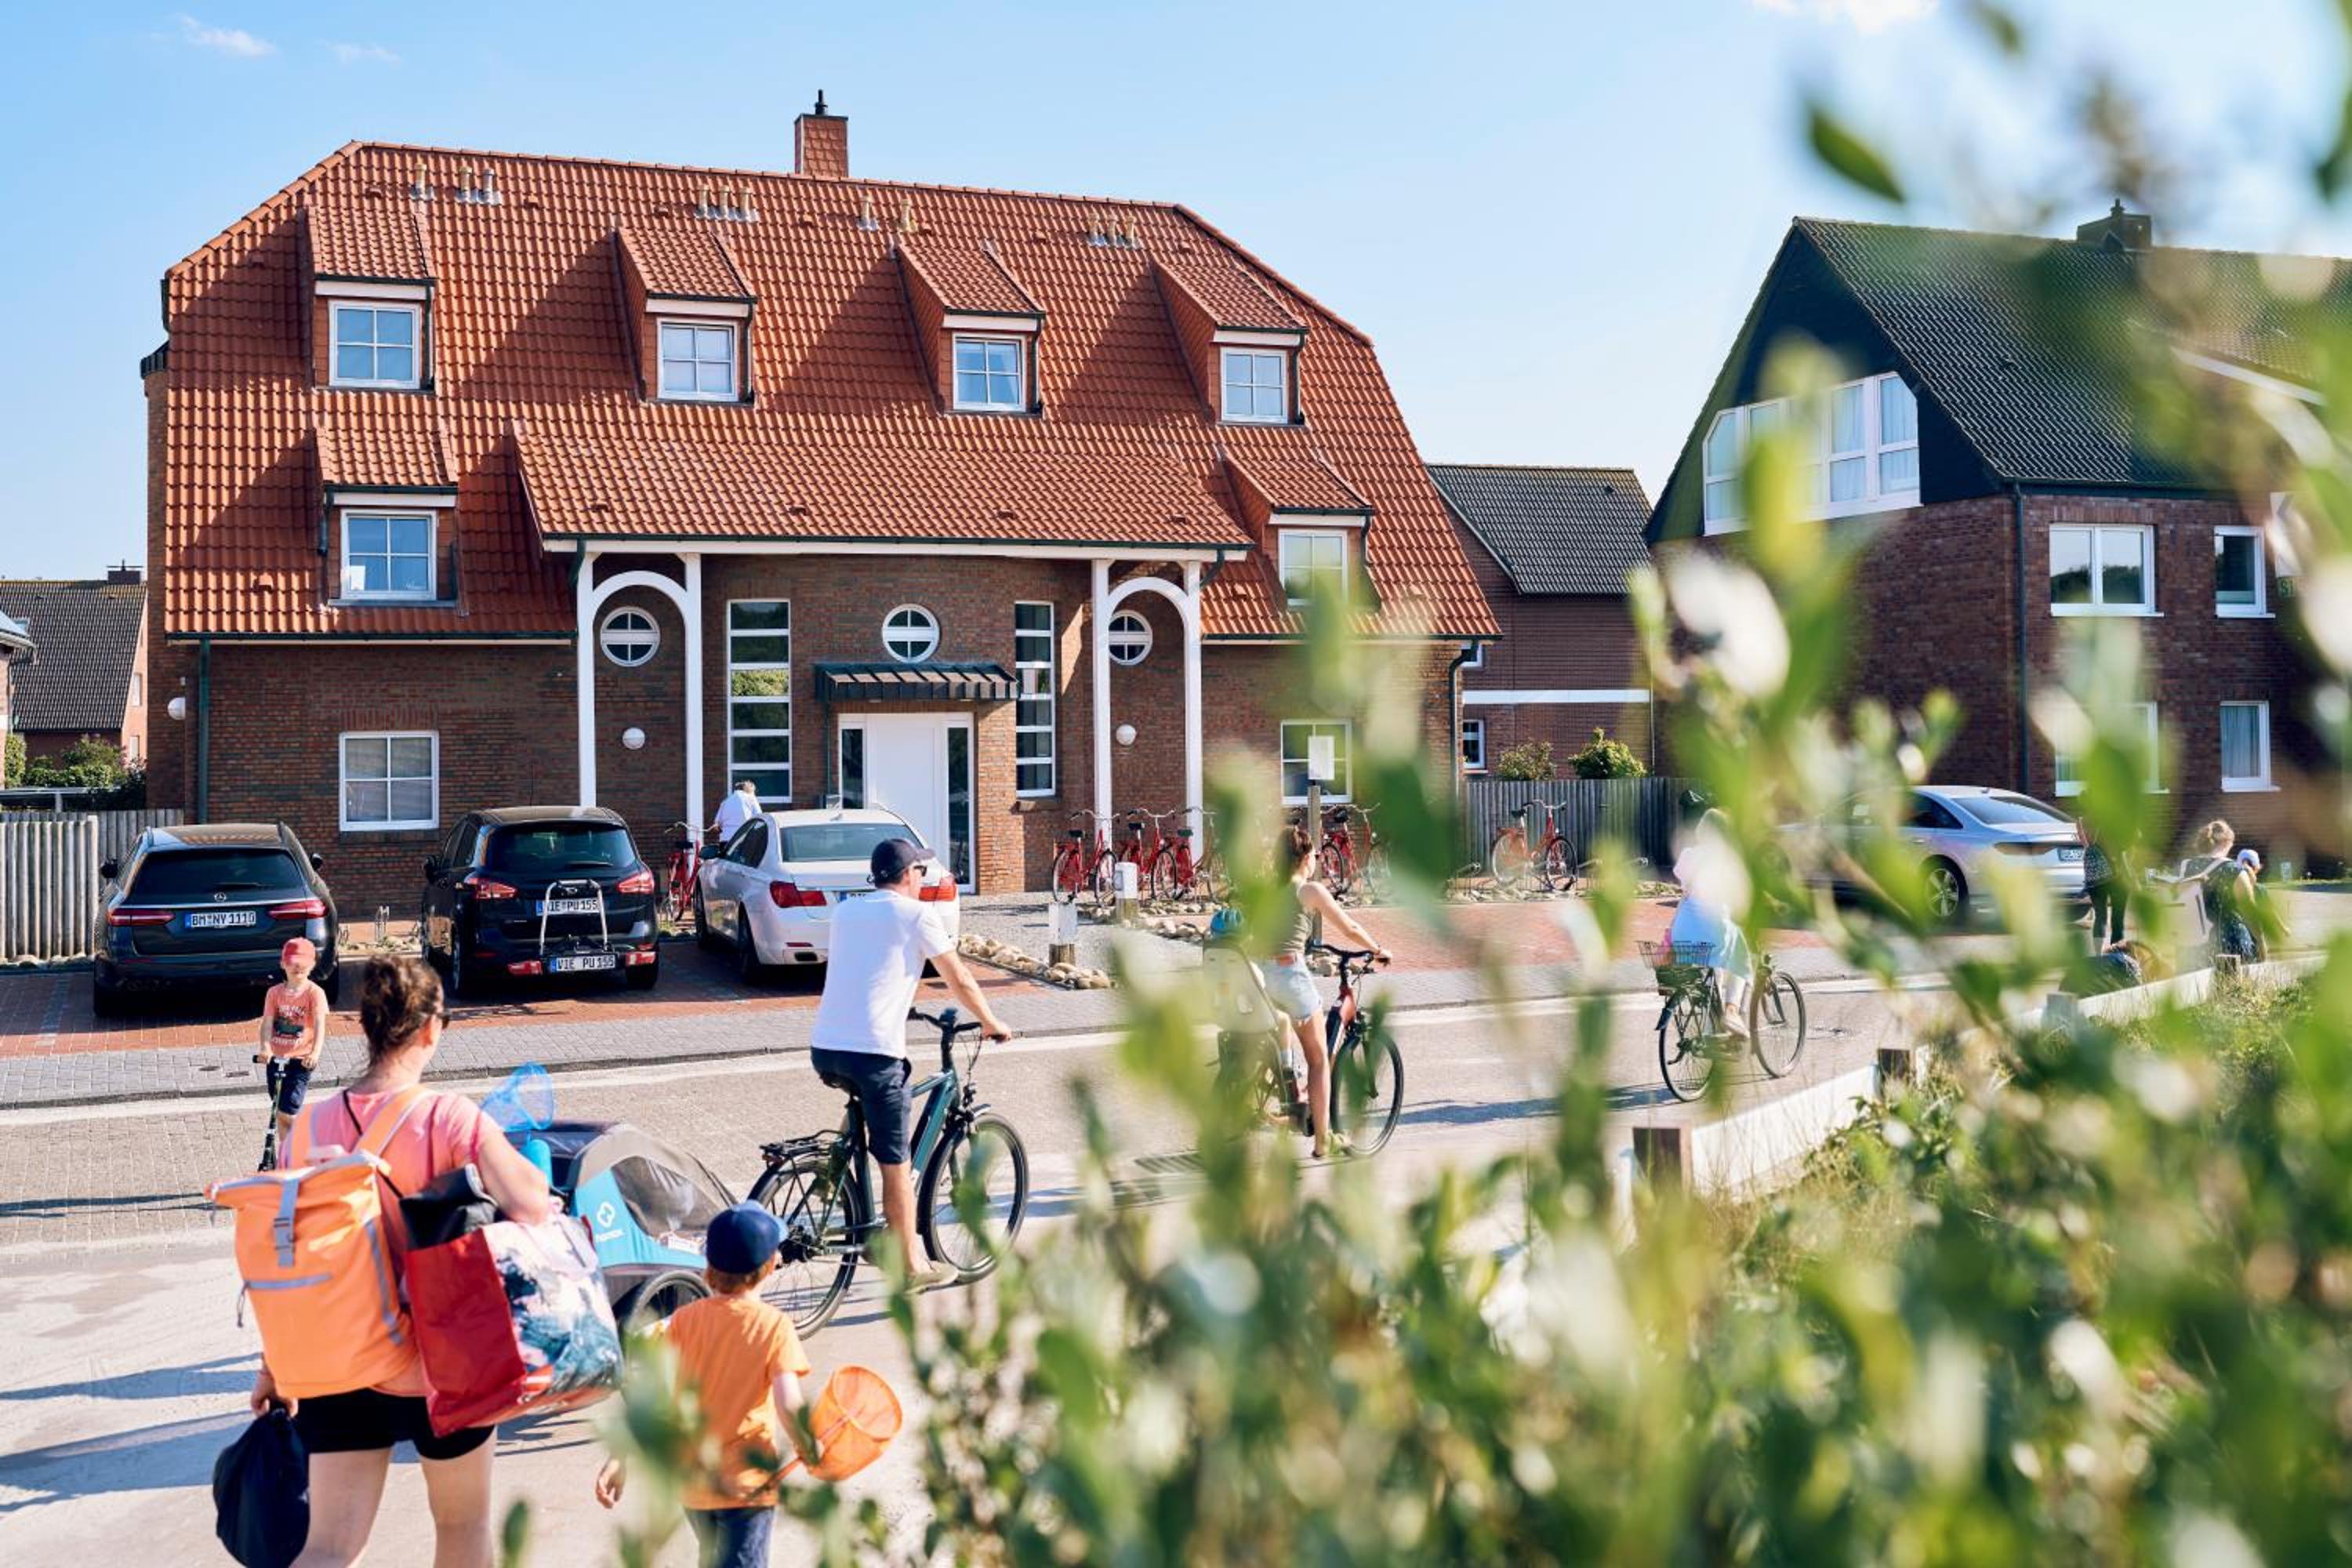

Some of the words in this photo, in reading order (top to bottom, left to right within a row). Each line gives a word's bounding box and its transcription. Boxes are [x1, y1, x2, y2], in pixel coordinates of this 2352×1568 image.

[567, 900, 579, 910] PU
[192, 914, 206, 926] BM
[212, 913, 227, 924] NY
[583, 957, 595, 968] PU
